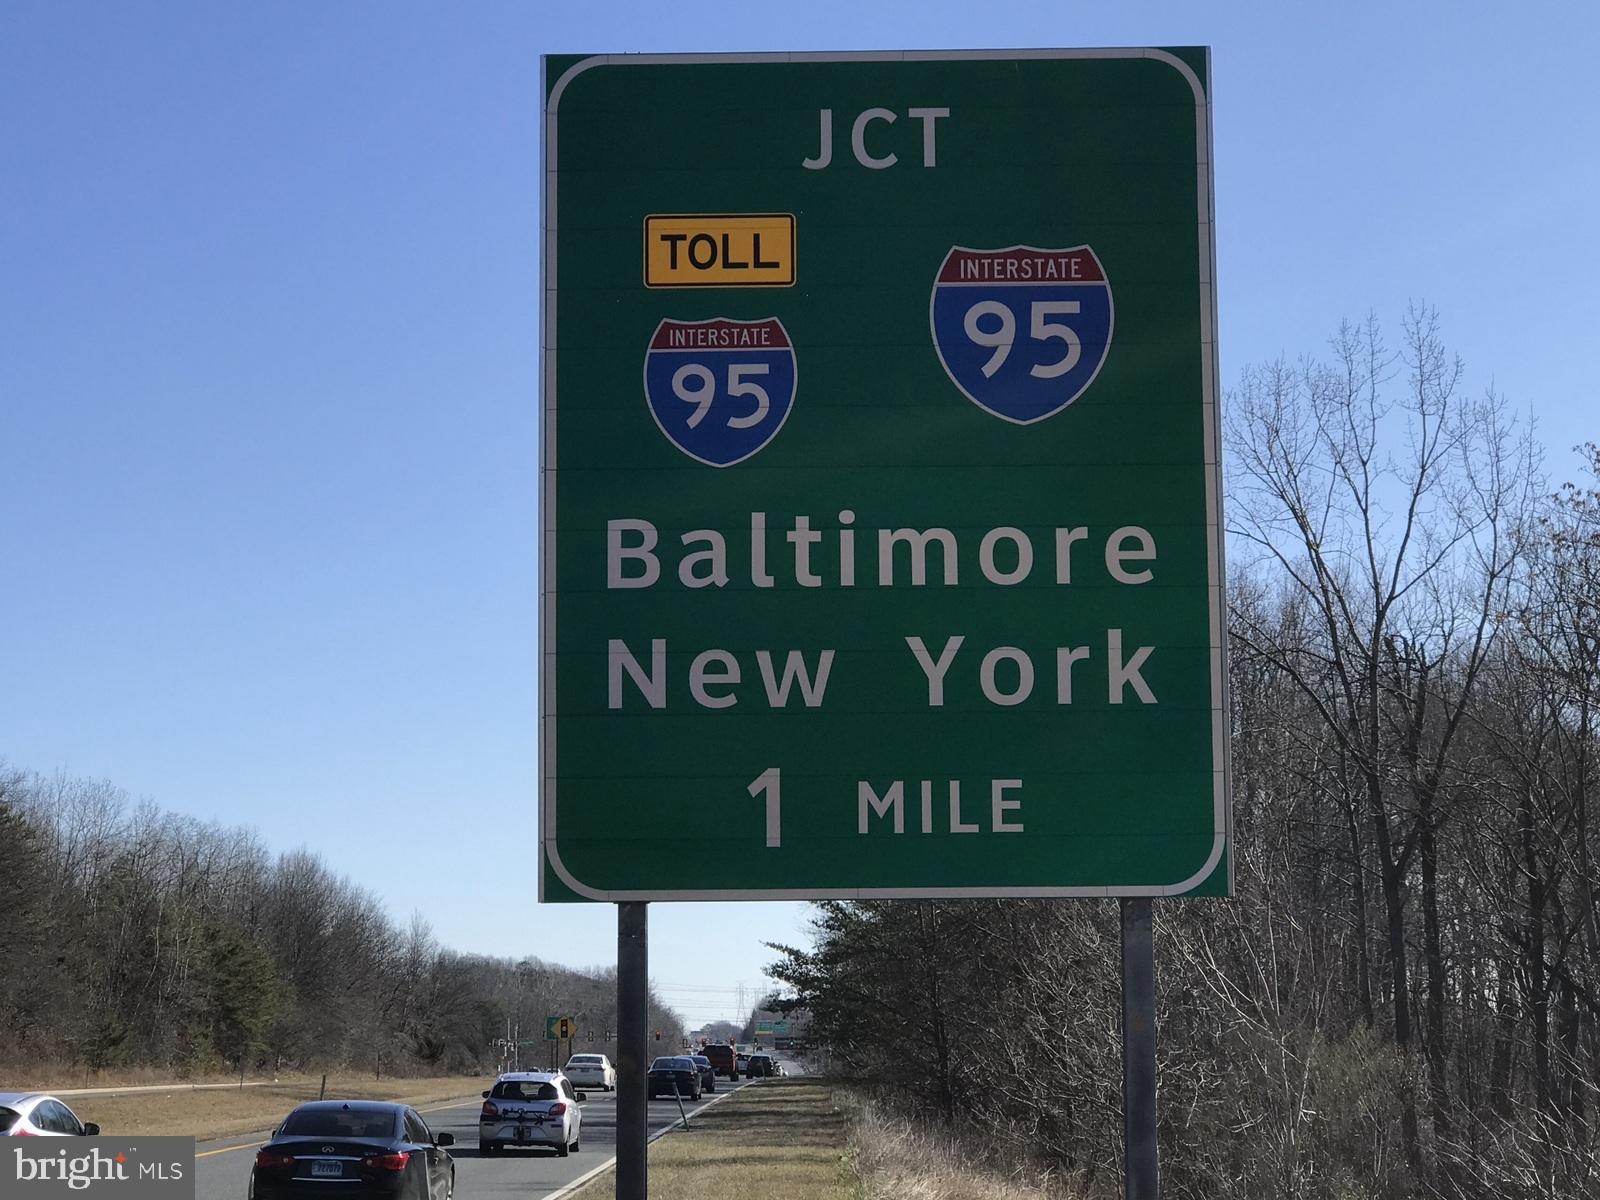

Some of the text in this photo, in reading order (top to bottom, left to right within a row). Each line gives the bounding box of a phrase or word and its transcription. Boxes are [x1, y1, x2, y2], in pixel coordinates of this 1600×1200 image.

[802, 107, 950, 170] JCT
[660, 232, 781, 271] TOLL
[959, 258, 1083, 279] INTERSTATE
[669, 328, 772, 346] INTERSTATE
[963, 300, 1082, 379] 95
[671, 363, 770, 429] 95
[606, 509, 1158, 589] Baltimore
[607, 628, 1158, 709] New York
[747, 767, 1025, 848] 1 MILE
